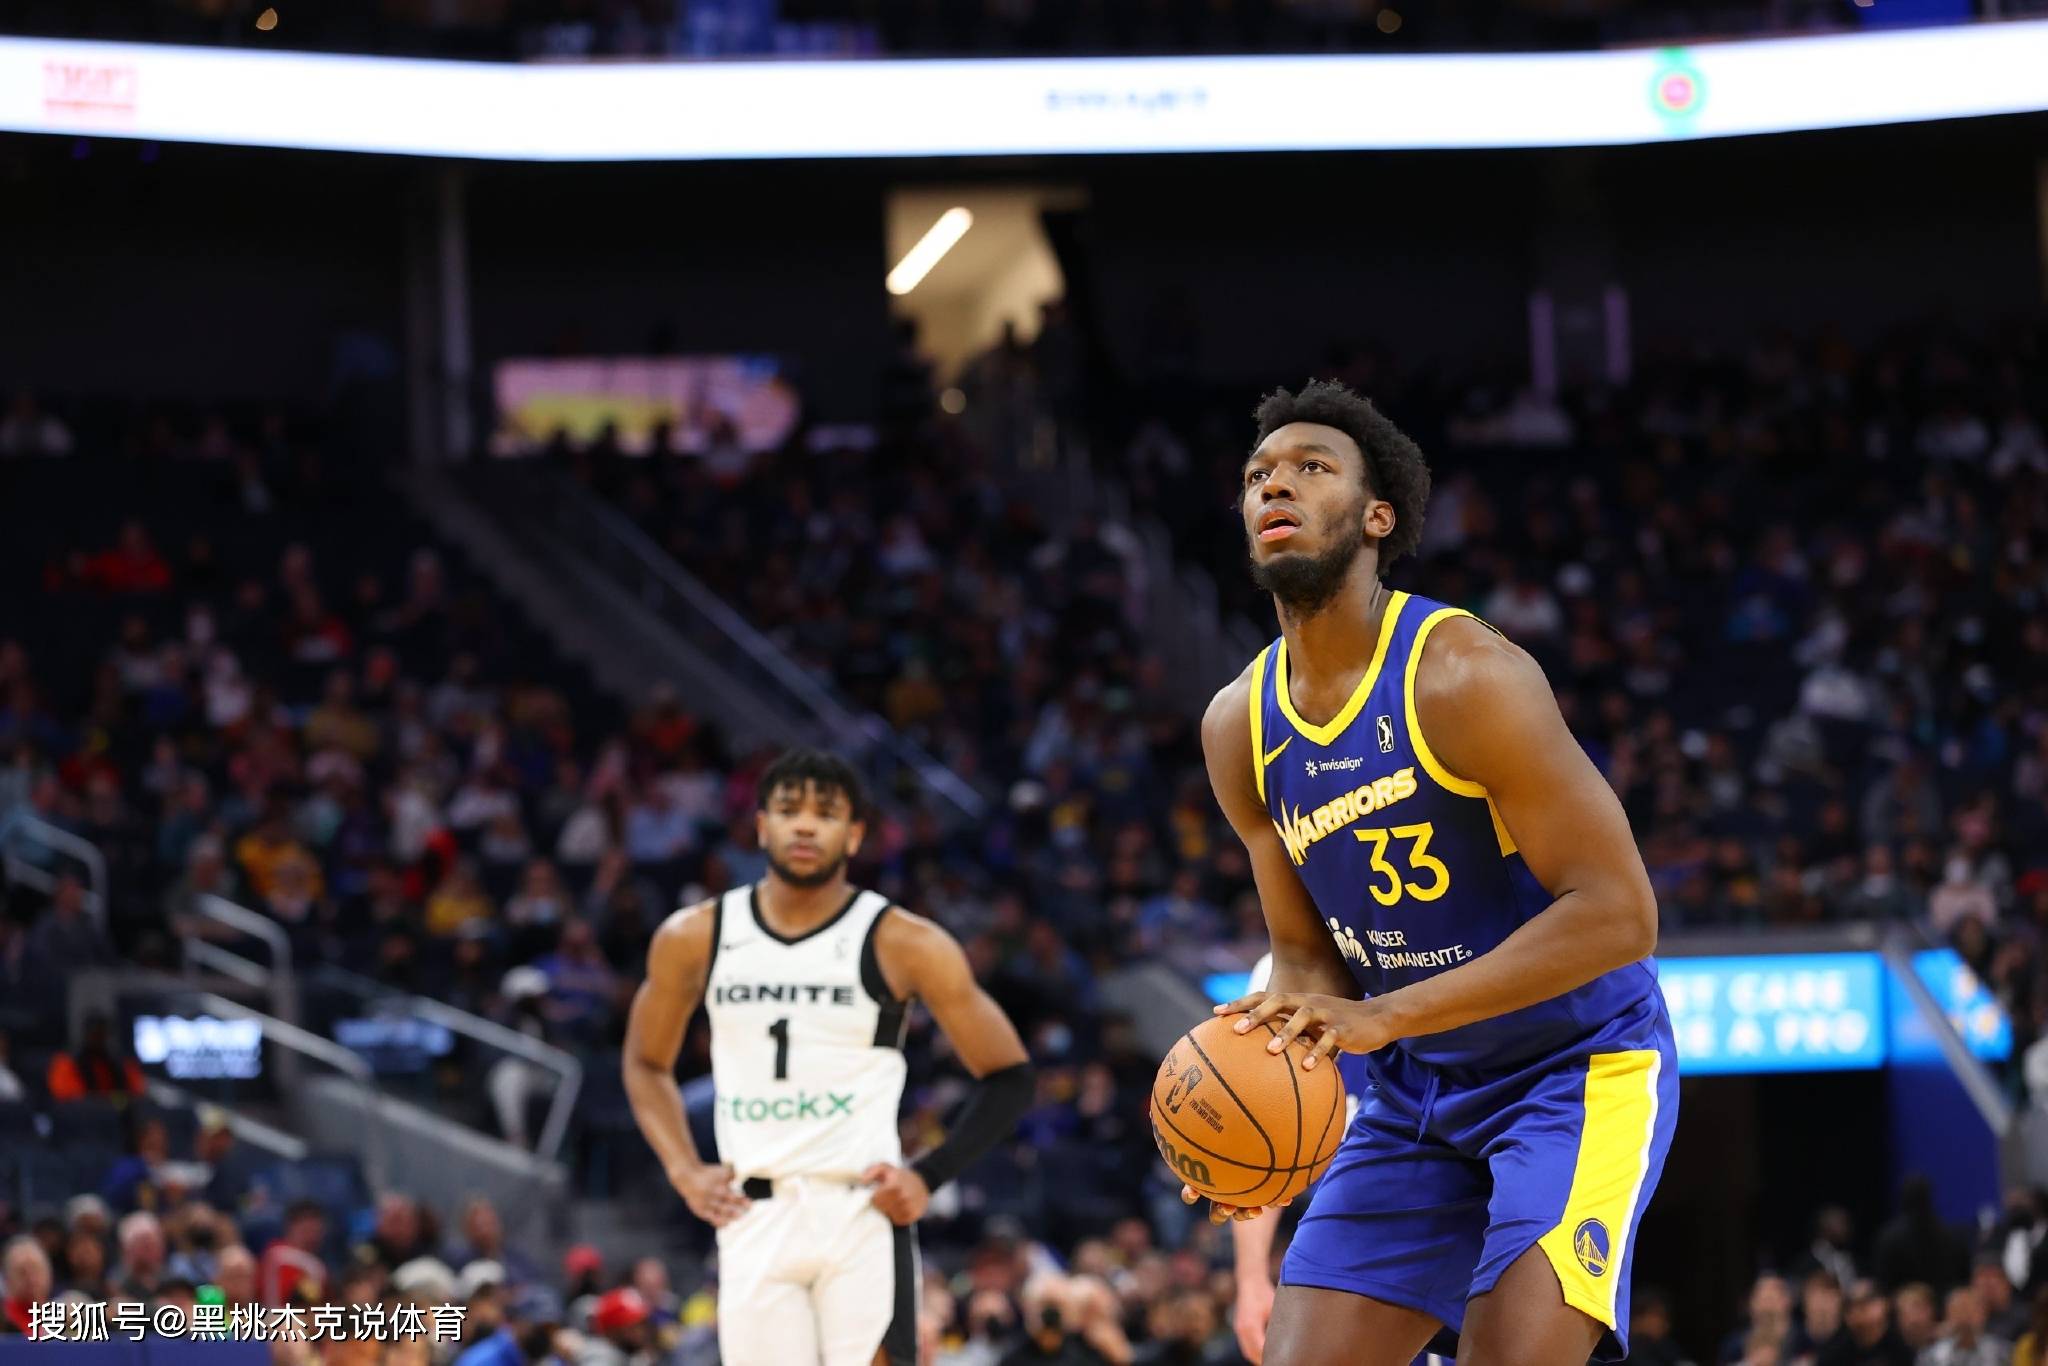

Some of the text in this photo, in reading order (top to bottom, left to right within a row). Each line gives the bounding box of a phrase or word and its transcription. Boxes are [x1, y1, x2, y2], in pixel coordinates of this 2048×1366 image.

[1272, 766, 1418, 866] WARRIORS
[1353, 822, 1450, 907] 33
[716, 984, 855, 1005] IGNITE
[769, 1017, 789, 1080] 1
